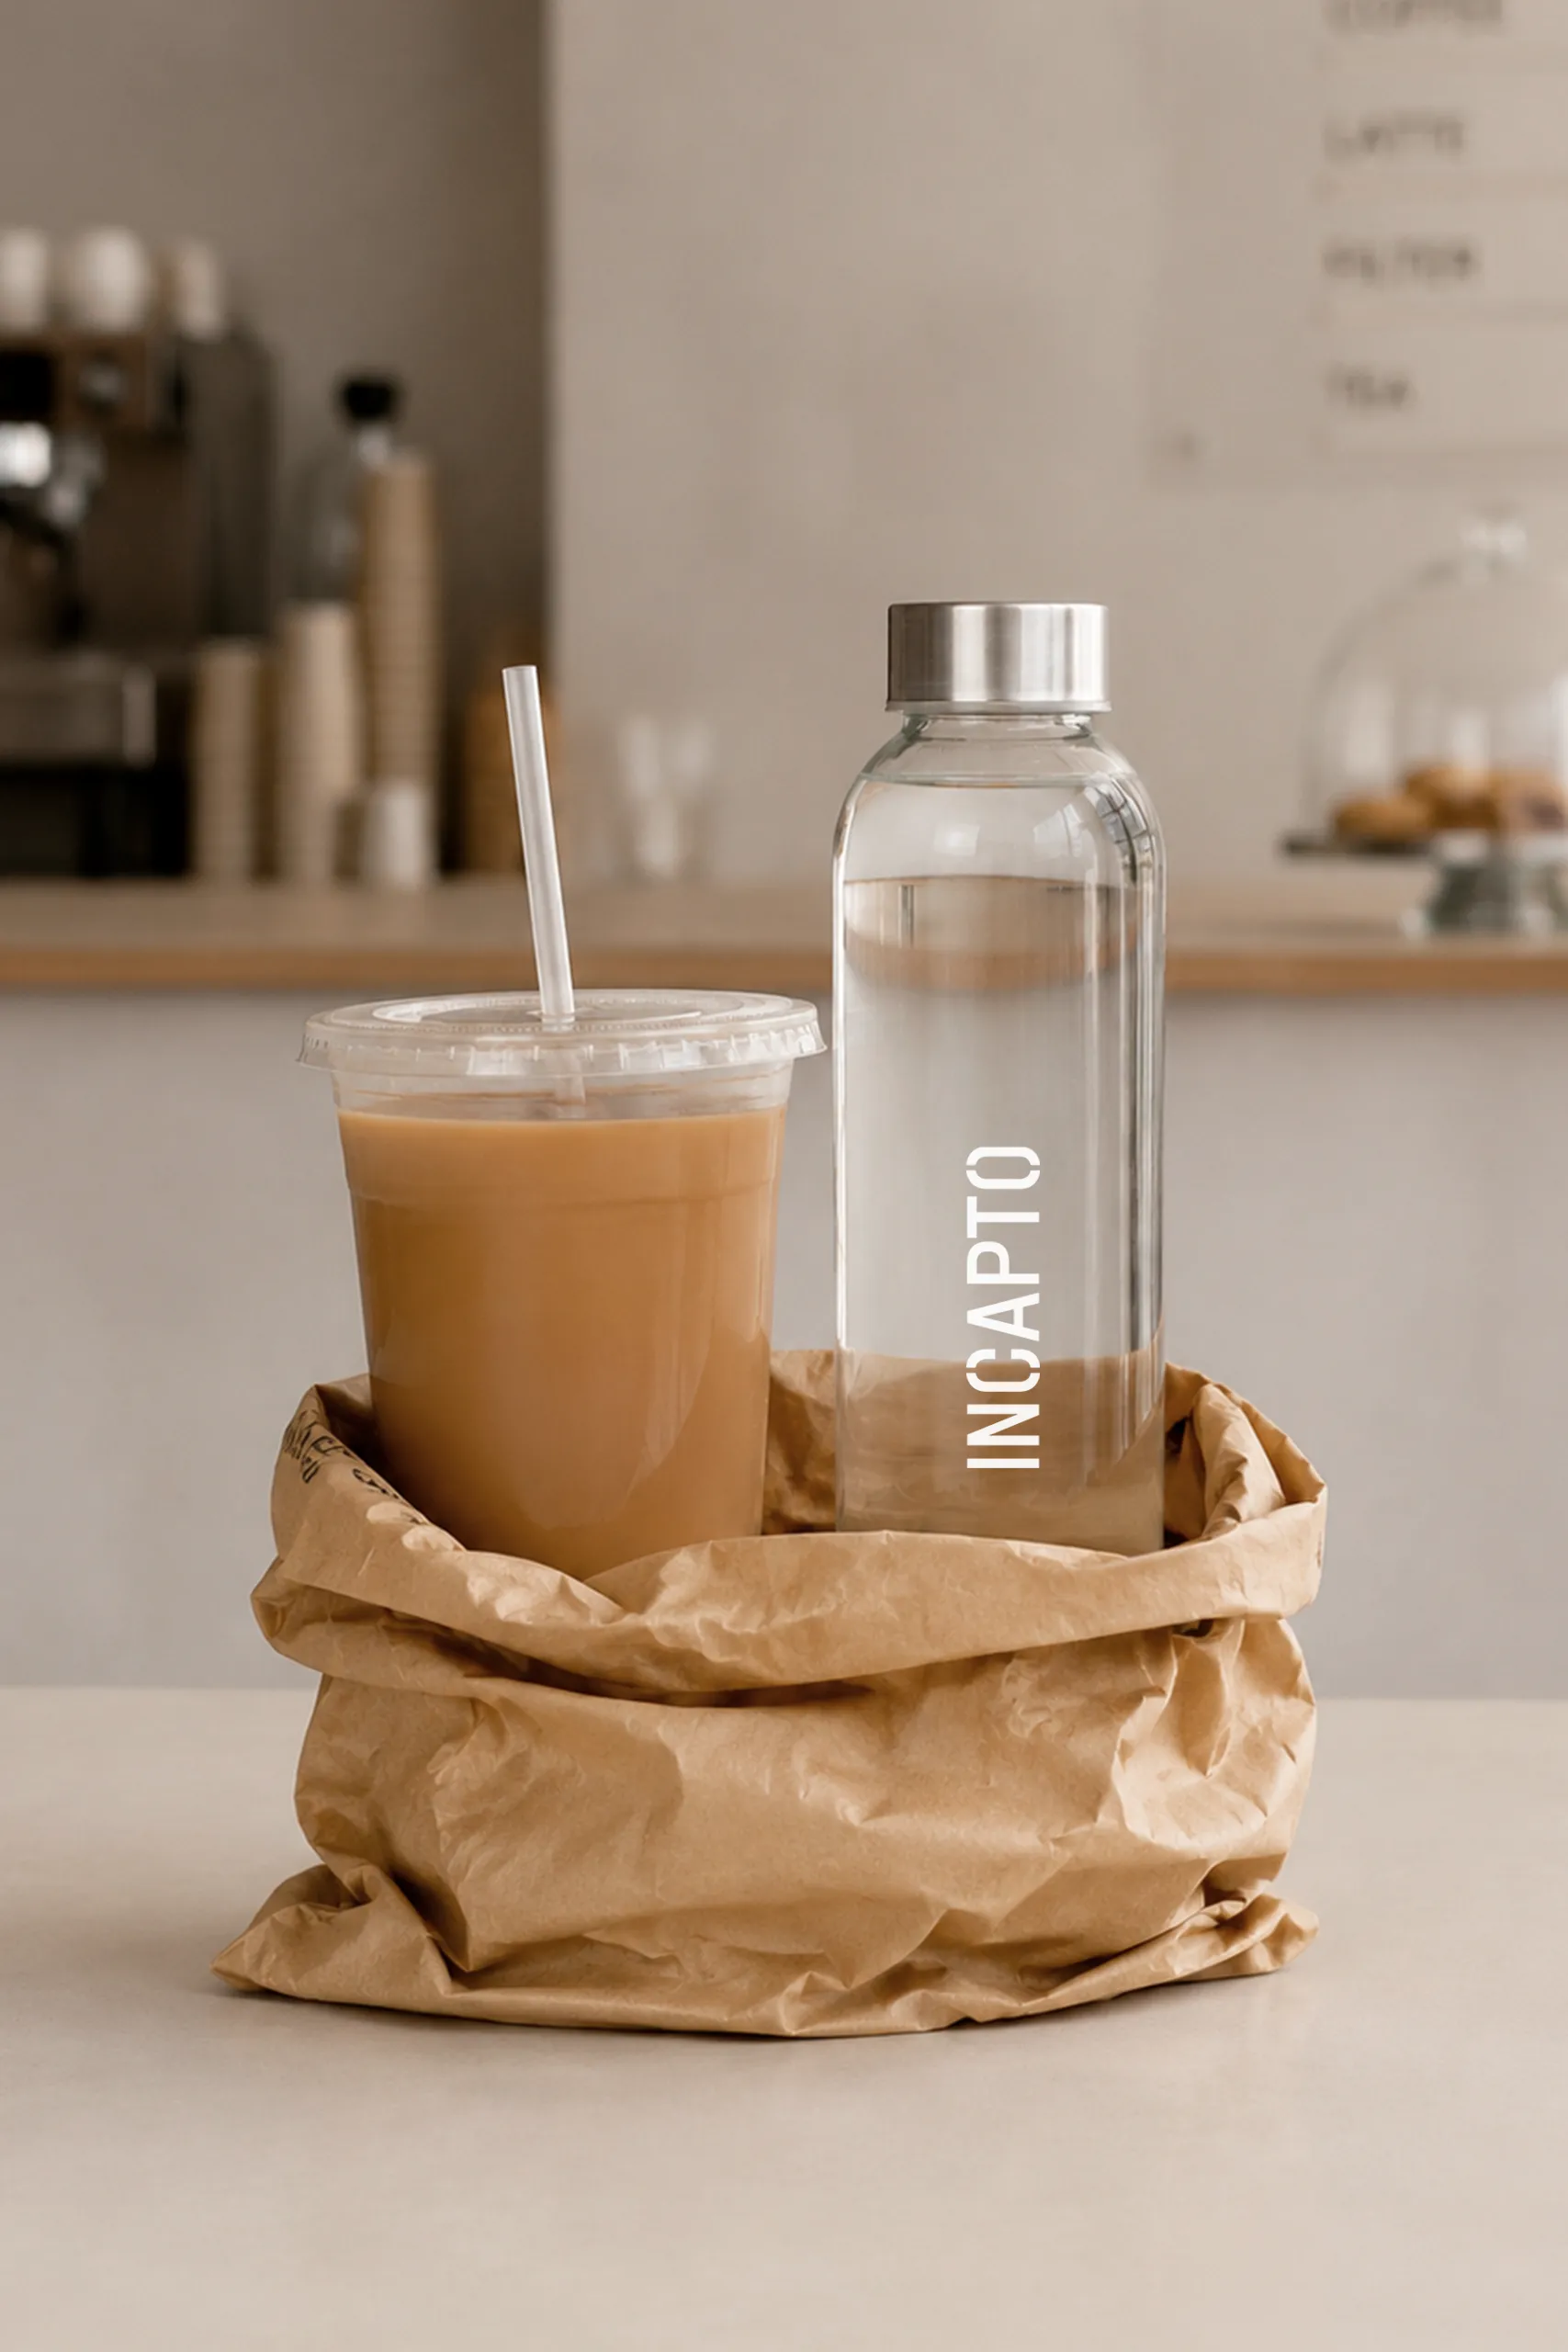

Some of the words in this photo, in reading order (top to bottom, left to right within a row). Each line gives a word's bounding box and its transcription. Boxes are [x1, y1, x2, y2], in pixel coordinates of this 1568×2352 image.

[1325, 112, 1465, 159] LATTE
[1325, 369, 1415, 413] TEA
[966, 1147, 1041, 1469] INCAPTO
